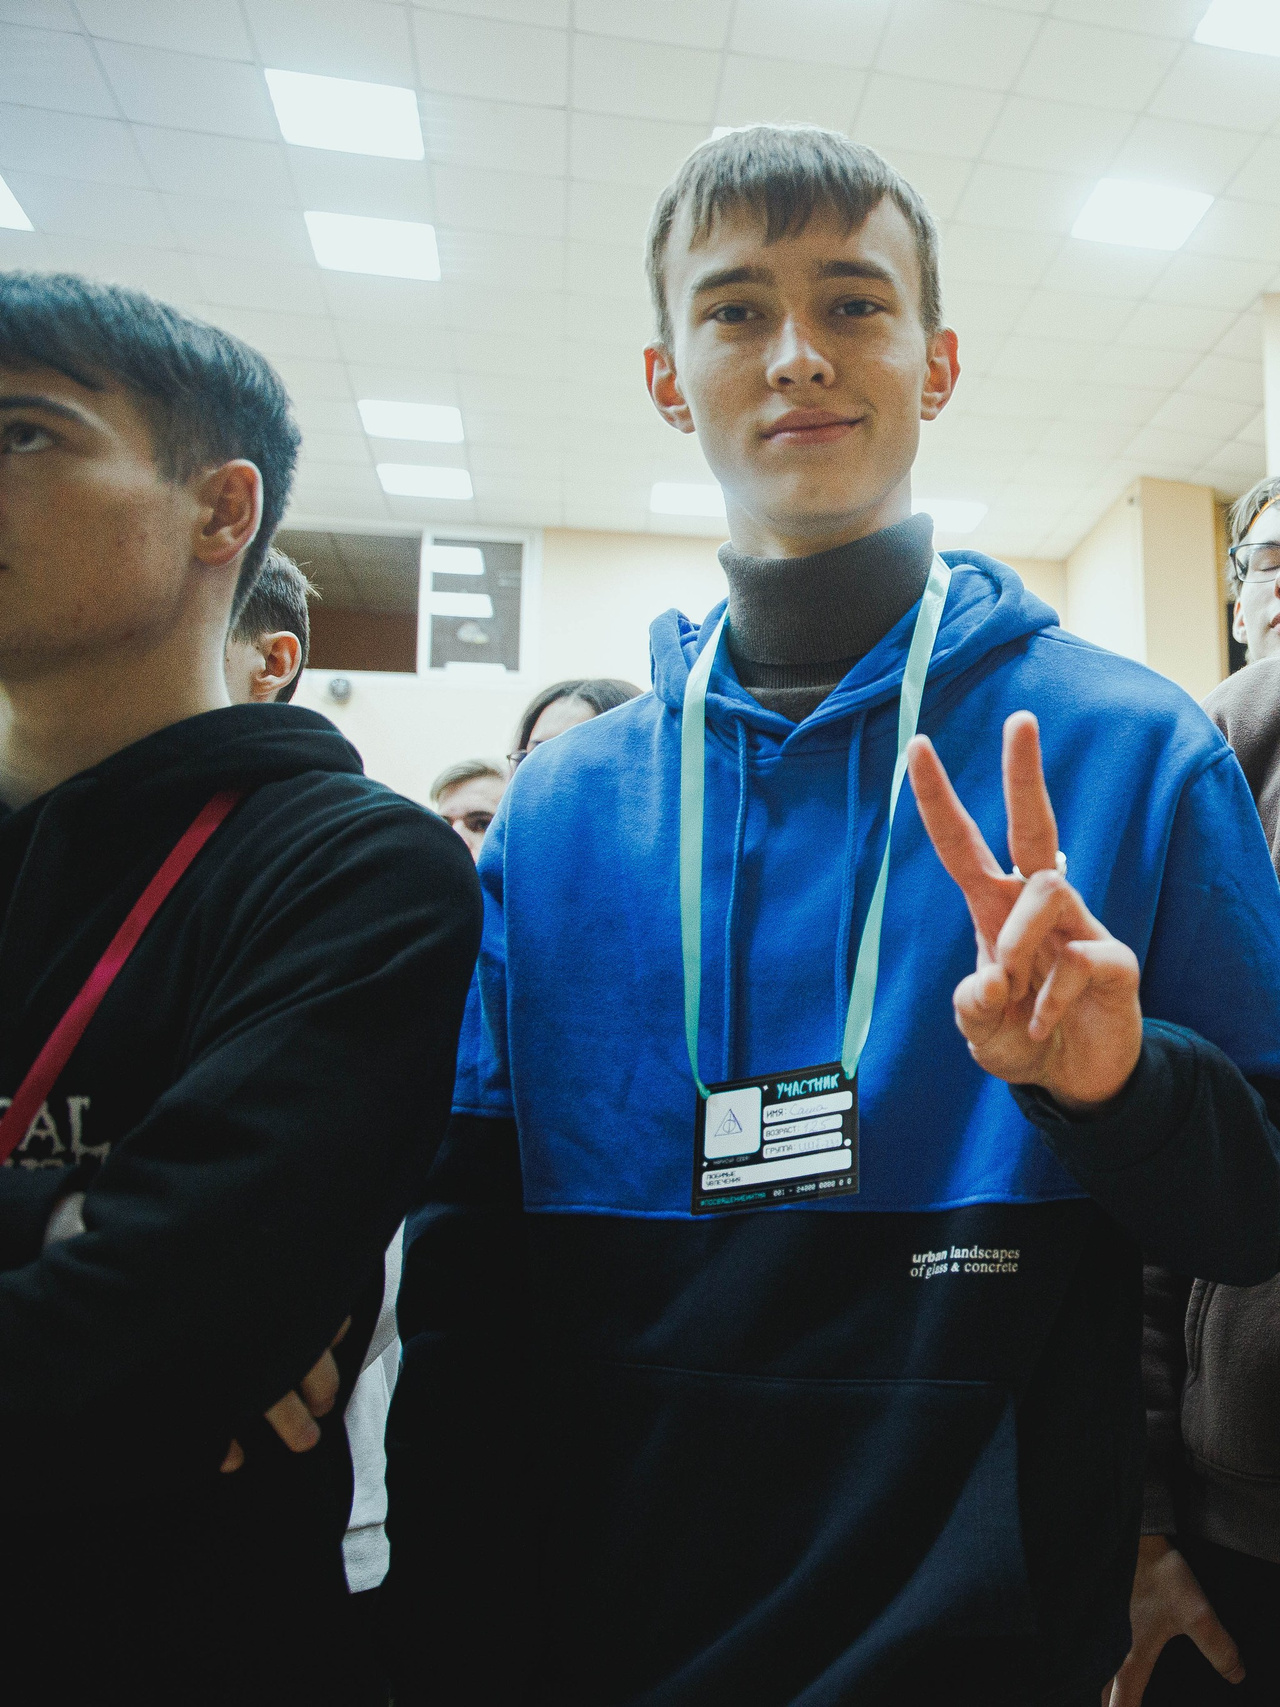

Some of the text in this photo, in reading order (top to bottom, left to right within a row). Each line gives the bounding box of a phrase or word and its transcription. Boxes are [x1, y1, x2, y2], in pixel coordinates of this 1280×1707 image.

[776, 1073, 840, 1099] УЧАСТНИК
[0, 1095, 112, 1166] AL
[912, 1245, 1020, 1263] urban landscapes
[910, 1261, 1018, 1279] of glass & concrete
